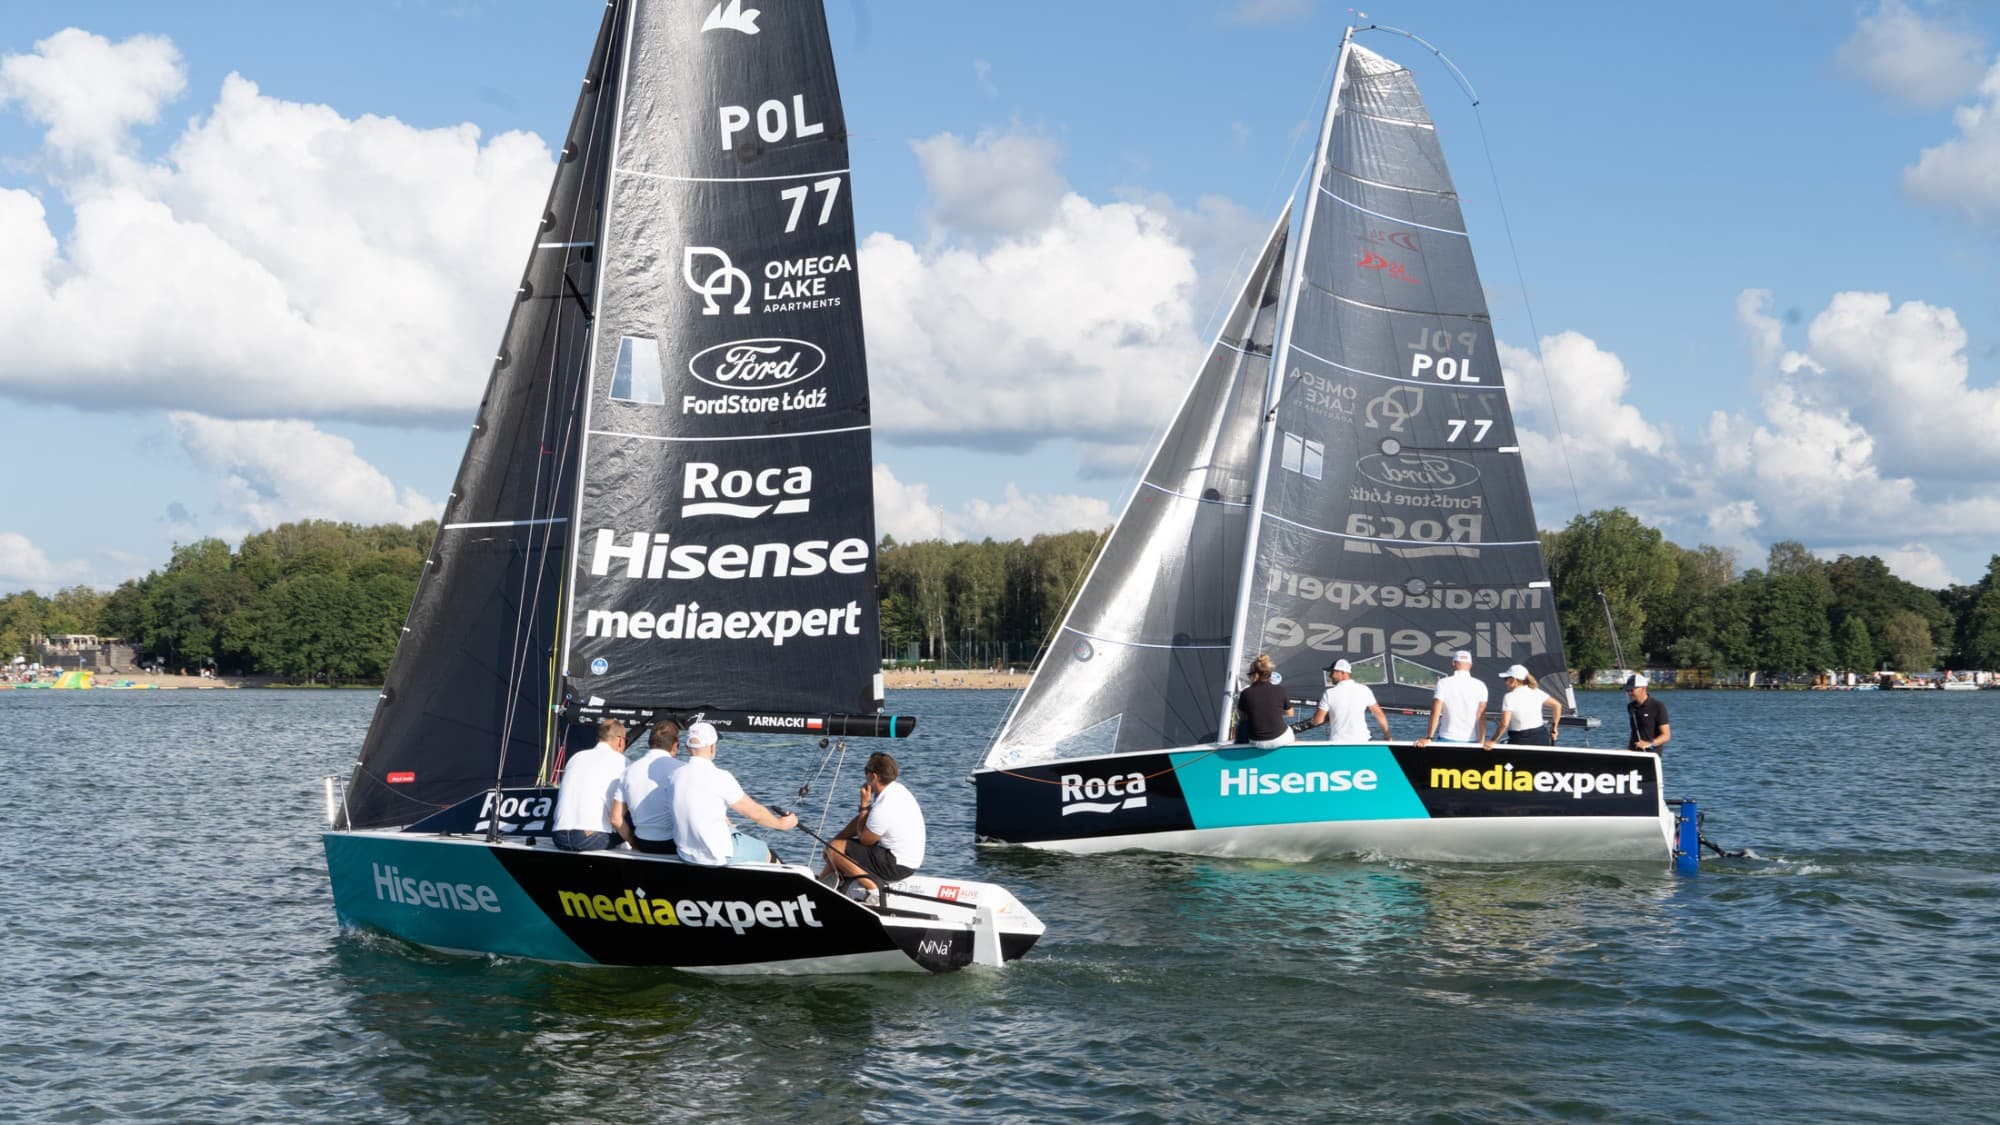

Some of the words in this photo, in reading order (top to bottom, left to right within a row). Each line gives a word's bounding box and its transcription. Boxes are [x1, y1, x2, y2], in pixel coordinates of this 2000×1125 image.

[719, 94, 824, 151] POL
[781, 177, 842, 233] 77
[764, 253, 852, 277] OMEGA
[763, 277, 826, 300] LAKE
[763, 297, 842, 313] APARTMENTS
[715, 345, 801, 382] Ford
[1411, 353, 1480, 383] POL
[682, 394, 779, 415] FordStore
[782, 387, 827, 412] Łódź
[1446, 419, 1494, 443] 77
[682, 462, 813, 499] Roca
[591, 528, 870, 580] Hisense
[586, 600, 862, 646] mediaexpert
[747, 715, 805, 728] TARNACKI
[1060, 771, 1147, 802] Roca
[1220, 768, 1378, 796] Hisense
[1430, 762, 1643, 799] mediaexpert
[479, 791, 552, 818] Roca
[372, 862, 502, 913] Hisense
[558, 886, 823, 936] mediaexpert
